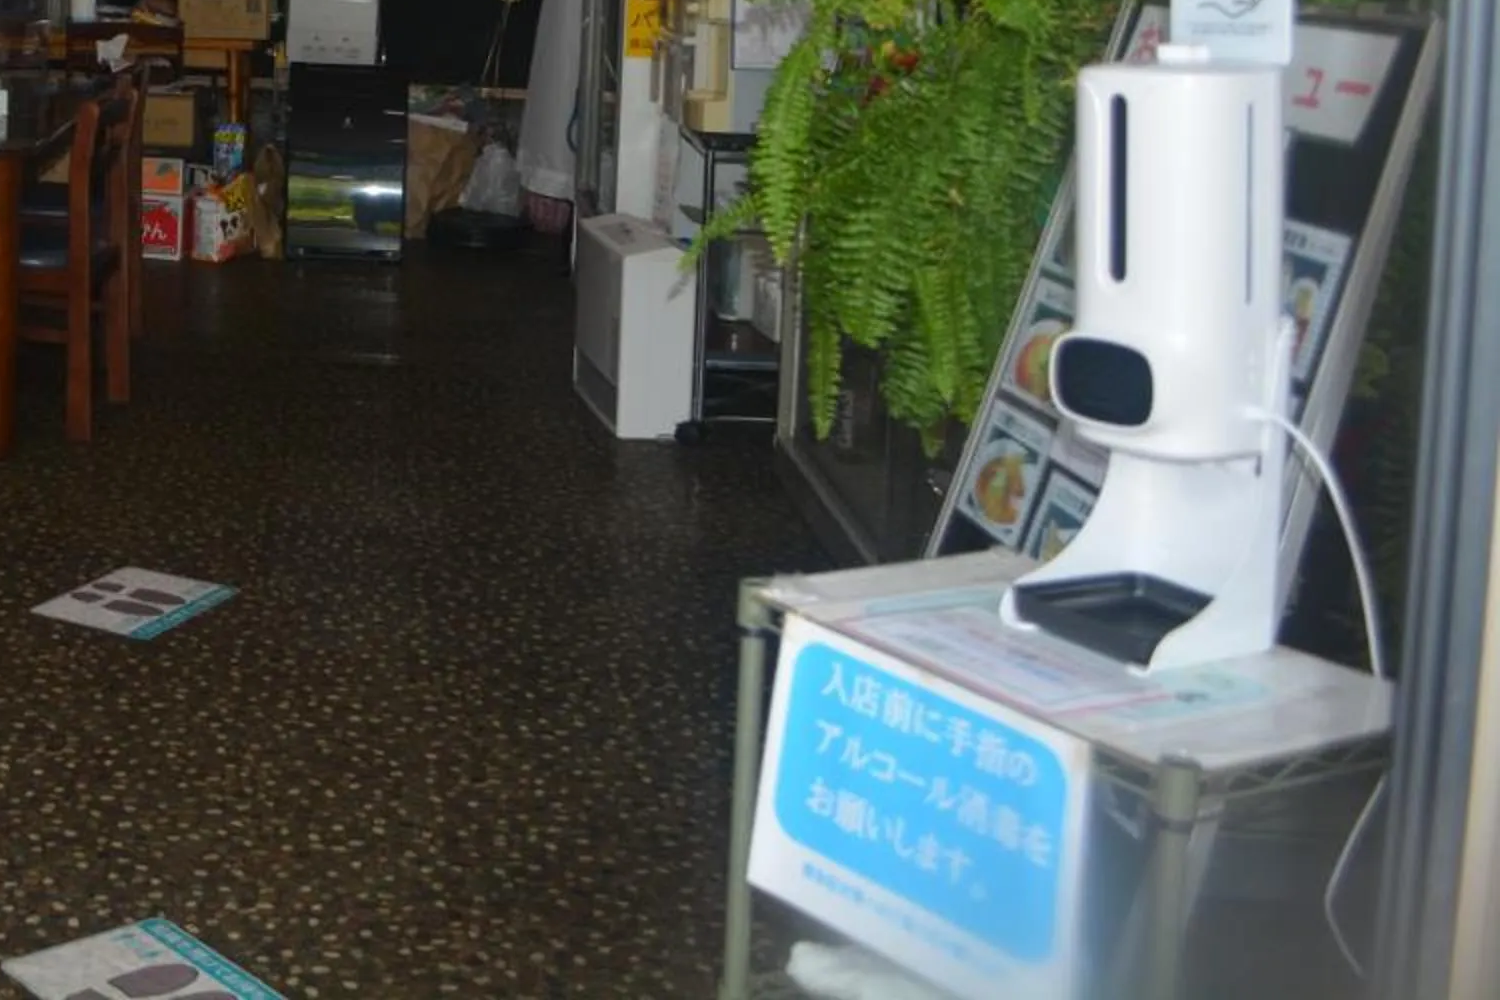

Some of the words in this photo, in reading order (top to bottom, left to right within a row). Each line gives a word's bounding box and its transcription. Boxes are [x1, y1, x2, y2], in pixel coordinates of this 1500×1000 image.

[821, 661, 1038, 787] 入店前に手指の
[805, 776, 988, 902] お願いします。
[815, 719, 1053, 867] アルコール消毒を
